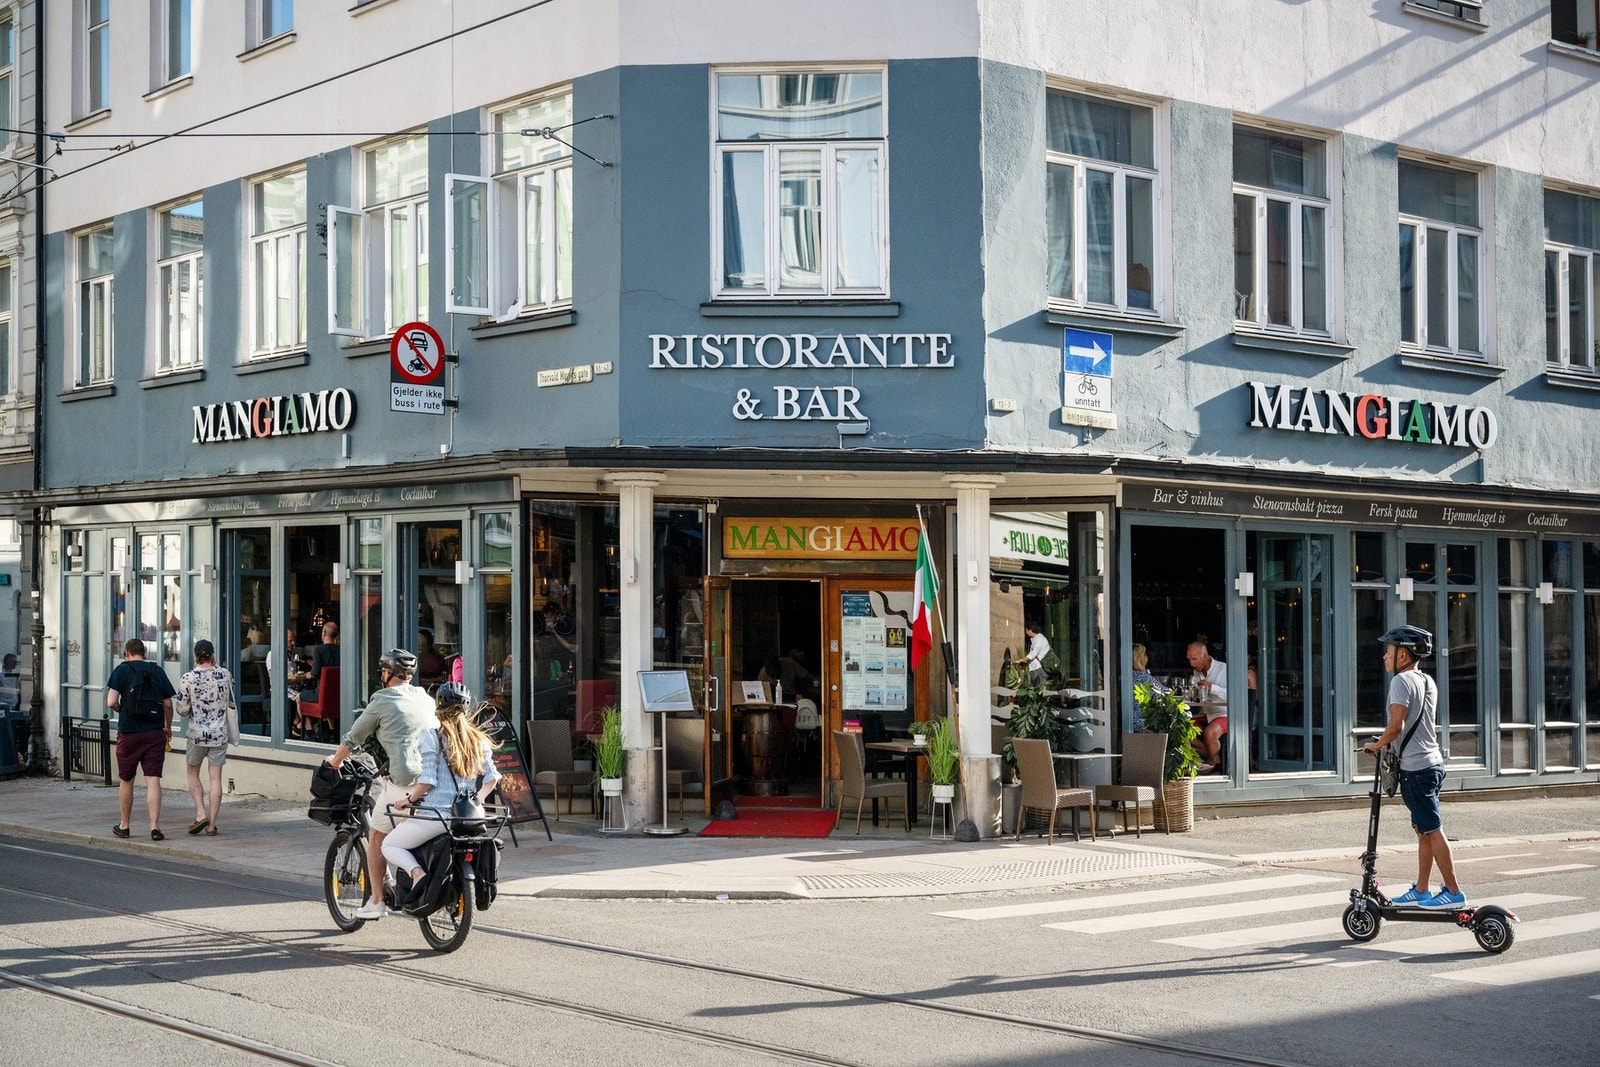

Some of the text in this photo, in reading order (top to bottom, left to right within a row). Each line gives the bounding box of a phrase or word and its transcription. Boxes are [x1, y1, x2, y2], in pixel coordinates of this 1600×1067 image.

[649, 333, 955, 369] RISTORANTE
[393, 386, 443, 399] Gjelder ikke
[1075, 398, 1101, 408] unntatt
[395, 398, 415, 408] buss
[423, 401, 441, 410] rute
[732, 386, 869, 421] & BAR
[192, 386, 353, 444] MANGIAMO
[1248, 380, 1498, 450] MANGIAMO
[331, 490, 380, 509] Hjemmelaget is
[400, 485, 437, 501] Coctailbar
[1152, 487, 1224, 508] Bar & vinhus
[1253, 494, 1343, 518] Stenovnsbakt pizza
[1369, 502, 1418, 522] Fersk pasta
[1442, 507, 1505, 528] Hjemmelaget is
[1527, 511, 1568, 528] Coctailbar
[730, 525, 922, 554] MANGIAMO
